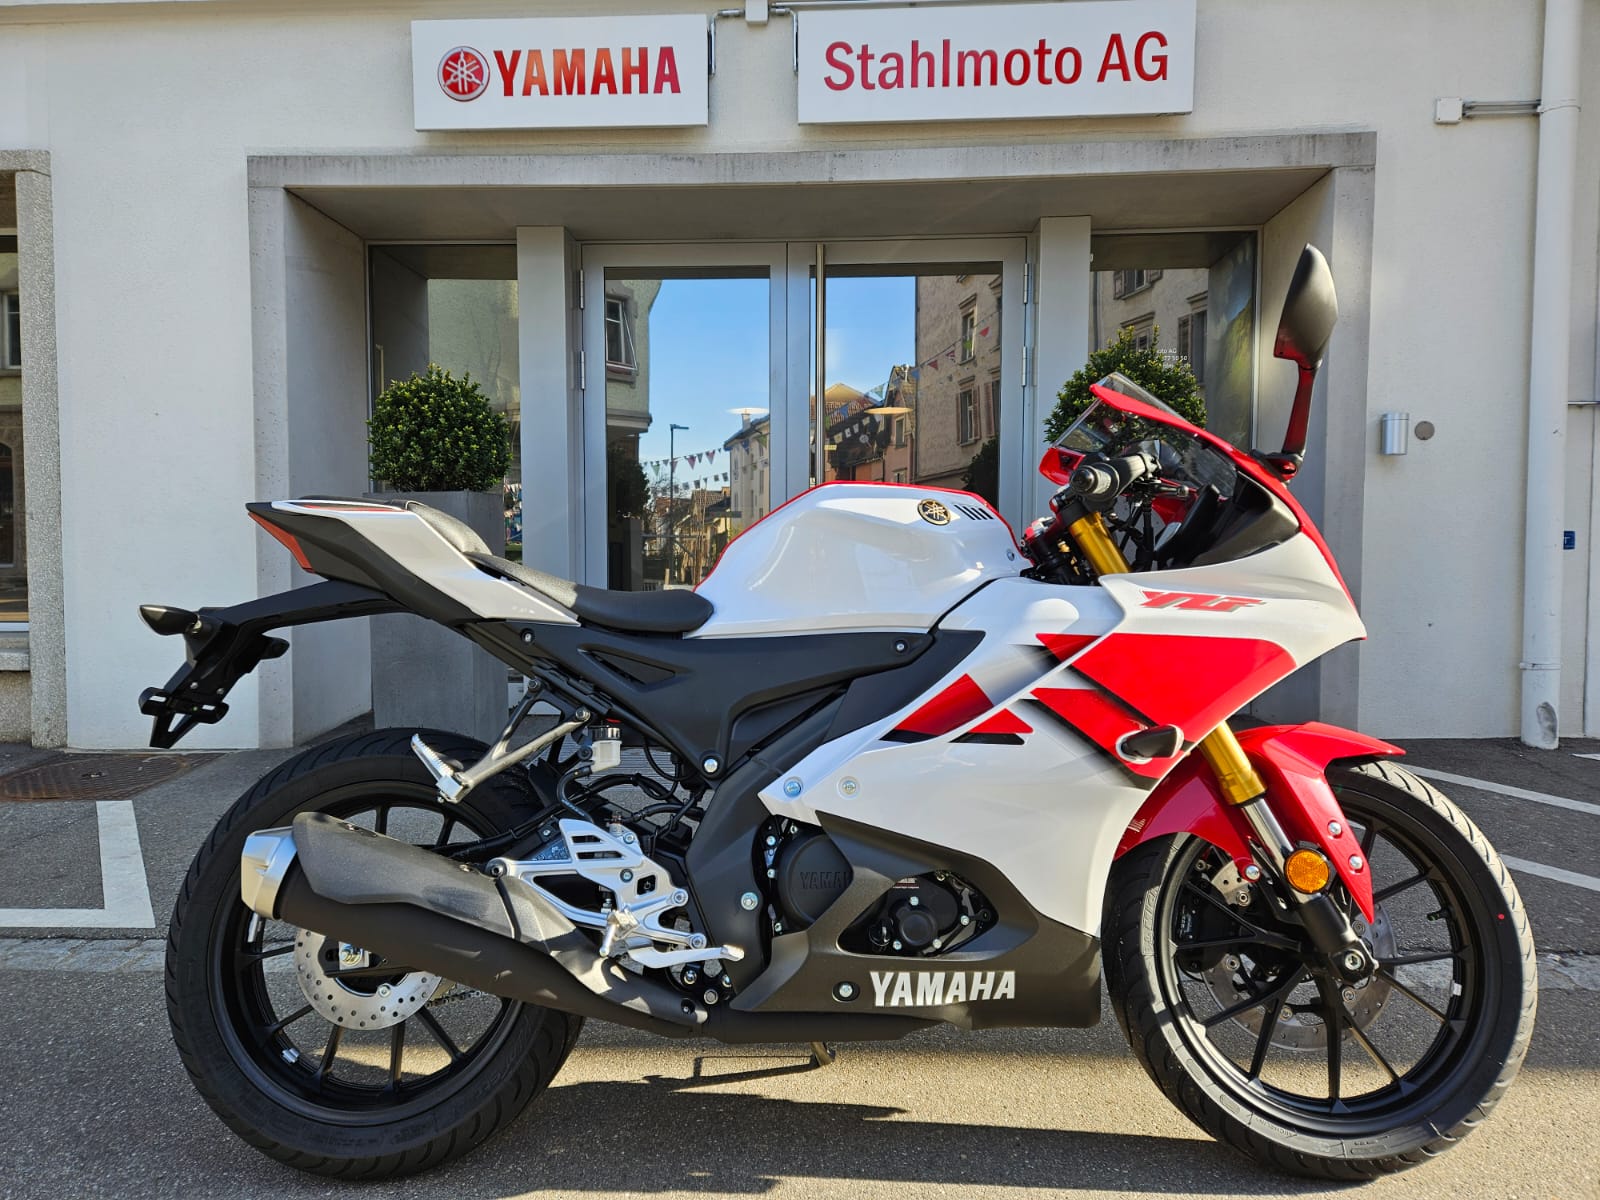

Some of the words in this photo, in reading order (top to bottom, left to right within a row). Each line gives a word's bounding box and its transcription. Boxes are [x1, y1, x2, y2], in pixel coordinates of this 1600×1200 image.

[493, 46, 681, 97] YAMAHA
[823, 39, 1083, 91] Stahlmoto
[1096, 31, 1169, 83] AG
[869, 971, 1016, 1007] YAMAHA
